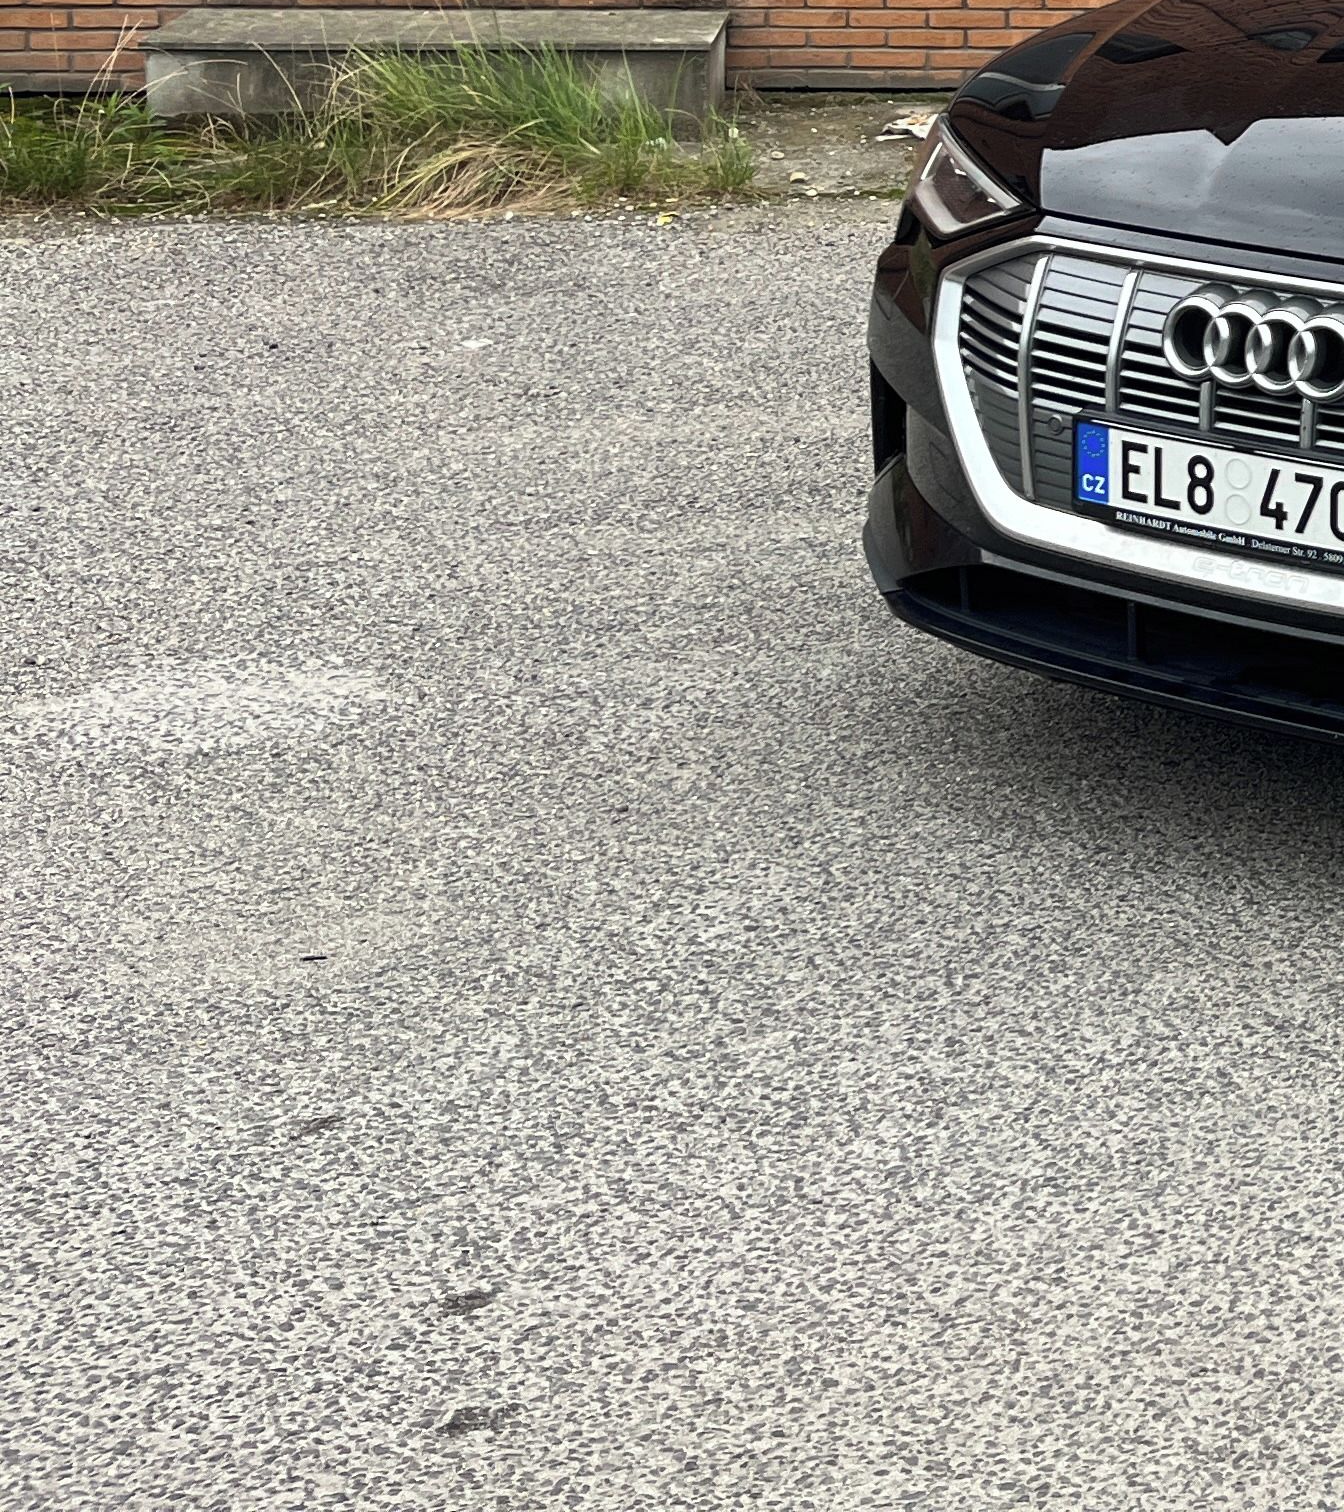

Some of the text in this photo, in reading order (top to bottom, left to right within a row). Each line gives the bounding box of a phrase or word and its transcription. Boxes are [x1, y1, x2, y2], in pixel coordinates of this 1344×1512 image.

[1081, 473, 1106, 495] CZ
[1120, 439, 1215, 515] EL8
[1115, 511, 1171, 530] REINHARDT
[1218, 532, 1245, 546] GmbH
[1306, 549, 1318, 559] 92
